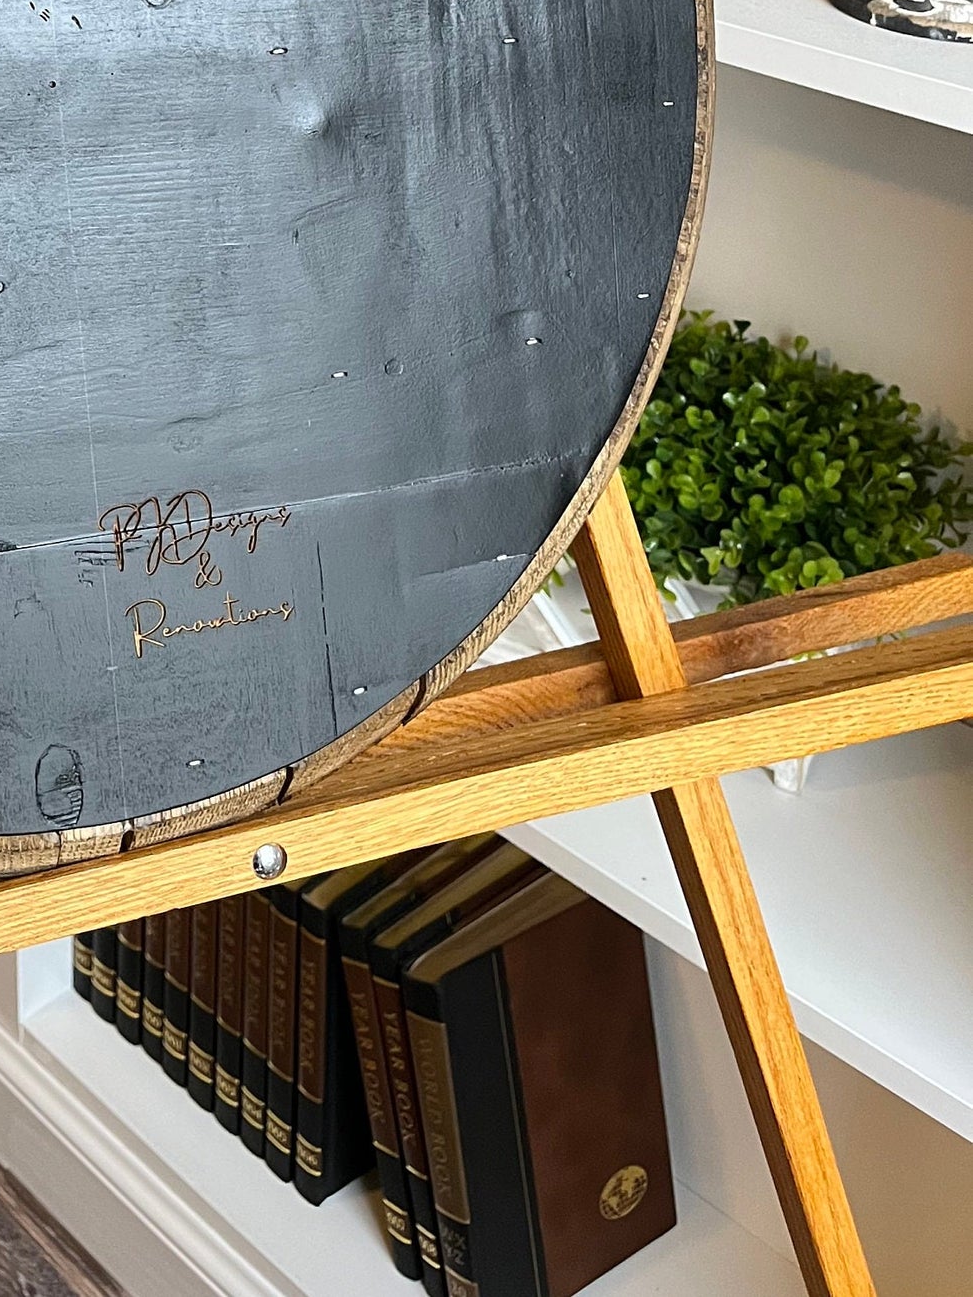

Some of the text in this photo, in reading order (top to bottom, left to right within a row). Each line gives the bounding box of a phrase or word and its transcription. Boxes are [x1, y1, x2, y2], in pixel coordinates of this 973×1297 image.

[193, 550, 223, 589] &
[124, 591, 296, 659] Renovations
[350, 992, 386, 1124] YEAR BOOK
[383, 1011, 417, 1146] YEAR BOOK
